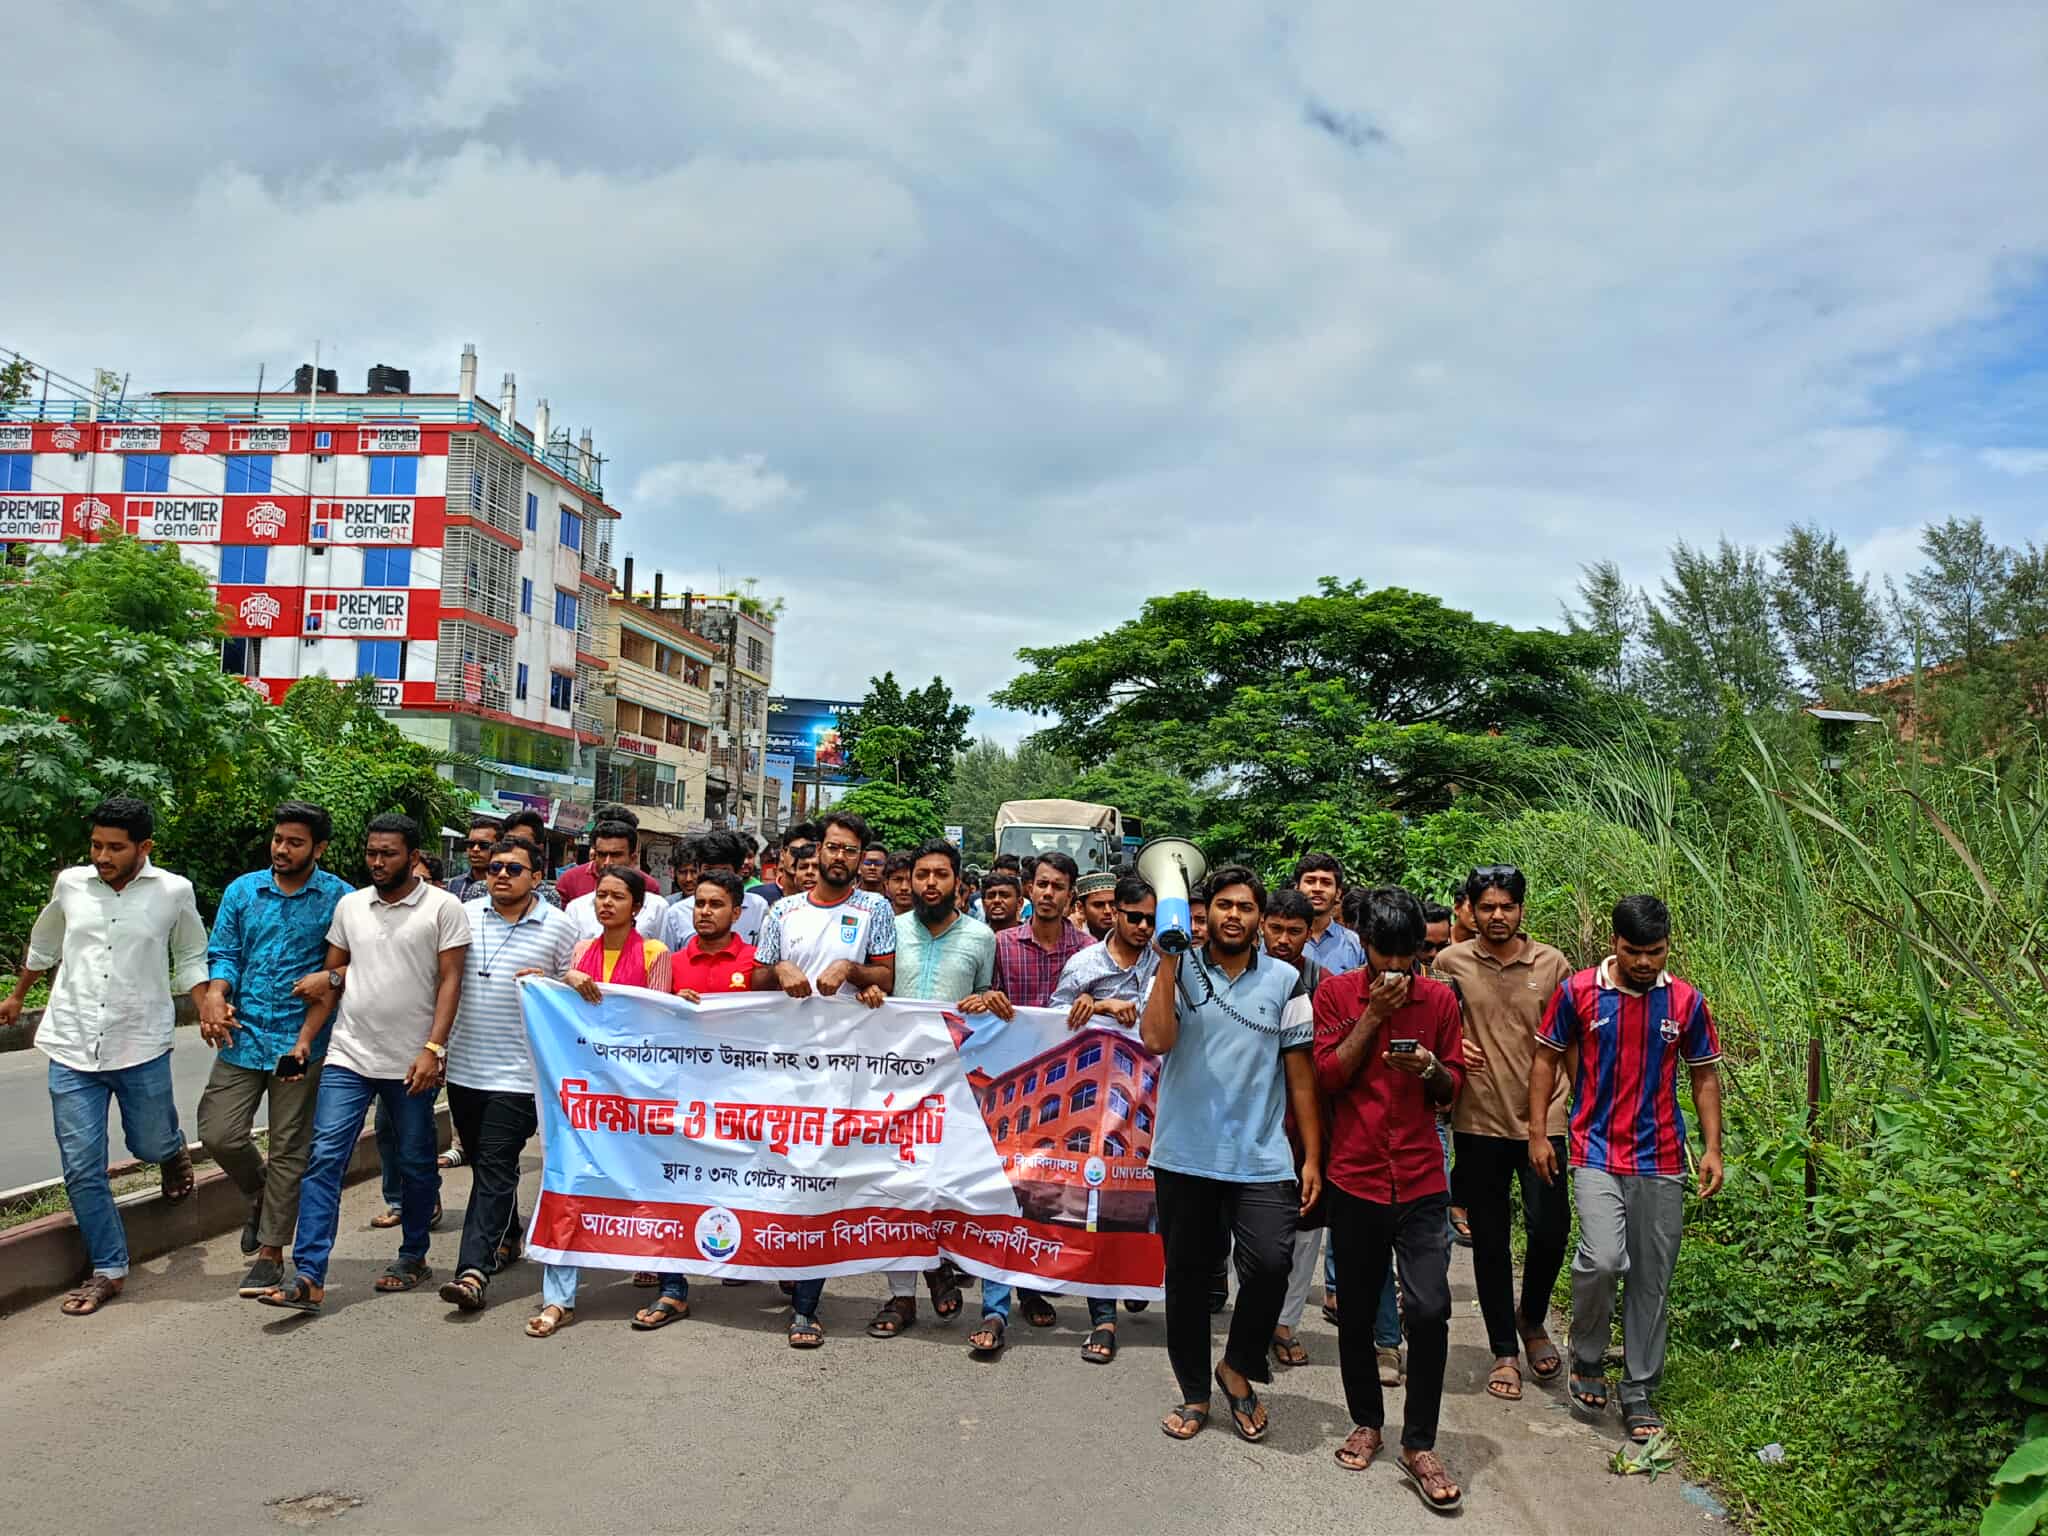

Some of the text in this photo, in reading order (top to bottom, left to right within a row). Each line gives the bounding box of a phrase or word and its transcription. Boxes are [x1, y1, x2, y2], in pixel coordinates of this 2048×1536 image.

[0, 428, 31, 440] REMIER
[120, 427, 160, 440] PREMIER
[249, 428, 289, 441] PREMIER
[378, 429, 419, 442] PREMIER
[0, 500, 61, 520] PREMIER
[155, 501, 218, 523] PREMIER
[345, 503, 411, 524] PREMIER
[338, 594, 405, 616] PREMIER
[592, 1039, 712, 1064] অবকাঠামোগত
[720, 1044, 767, 1069] উন্নয়ন
[774, 1051, 799, 1070] সহ
[805, 1055, 819, 1070] ৩
[827, 1054, 862, 1073] দফা
[560, 1078, 946, 1164] বিক্ষোভ ও অবস্থান কর্মসূচি
[663, 1163, 690, 1181] স্থান
[709, 1168, 739, 1187] ৩নং
[744, 1169, 785, 1189] গেটের
[790, 1174, 837, 1193] সামনে
[753, 1223, 825, 1250] বরিশাল
